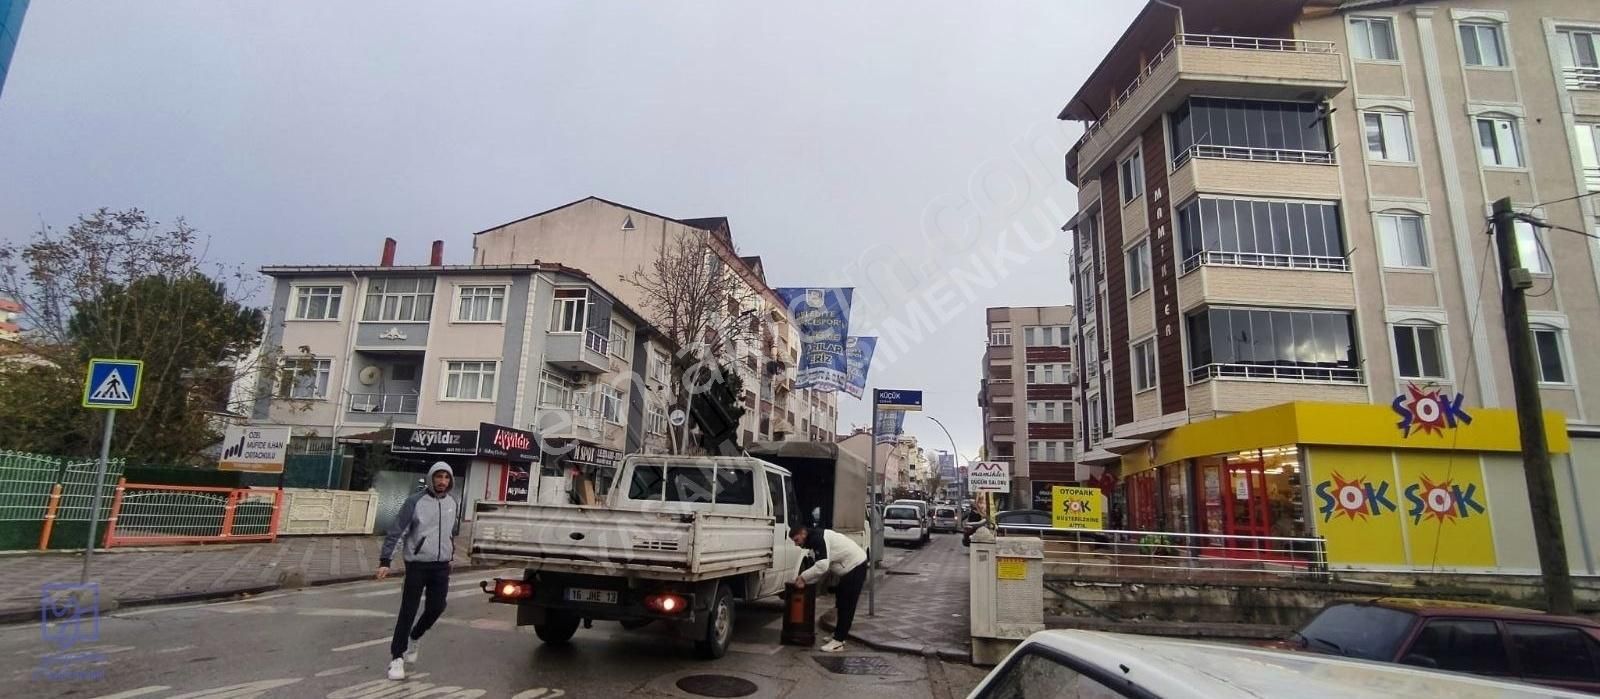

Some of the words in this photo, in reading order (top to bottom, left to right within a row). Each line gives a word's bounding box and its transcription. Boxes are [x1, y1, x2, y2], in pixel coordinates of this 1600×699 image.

[879, 391, 902, 400] KÜÇÜK
[1391, 391, 1473, 439] ŞOK
[1060, 488, 1094, 496] OTOPARK
[1063, 499, 1092, 515] ŞOK
[1315, 479, 1397, 523] ŞOK
[1404, 481, 1486, 526] ŞOK
